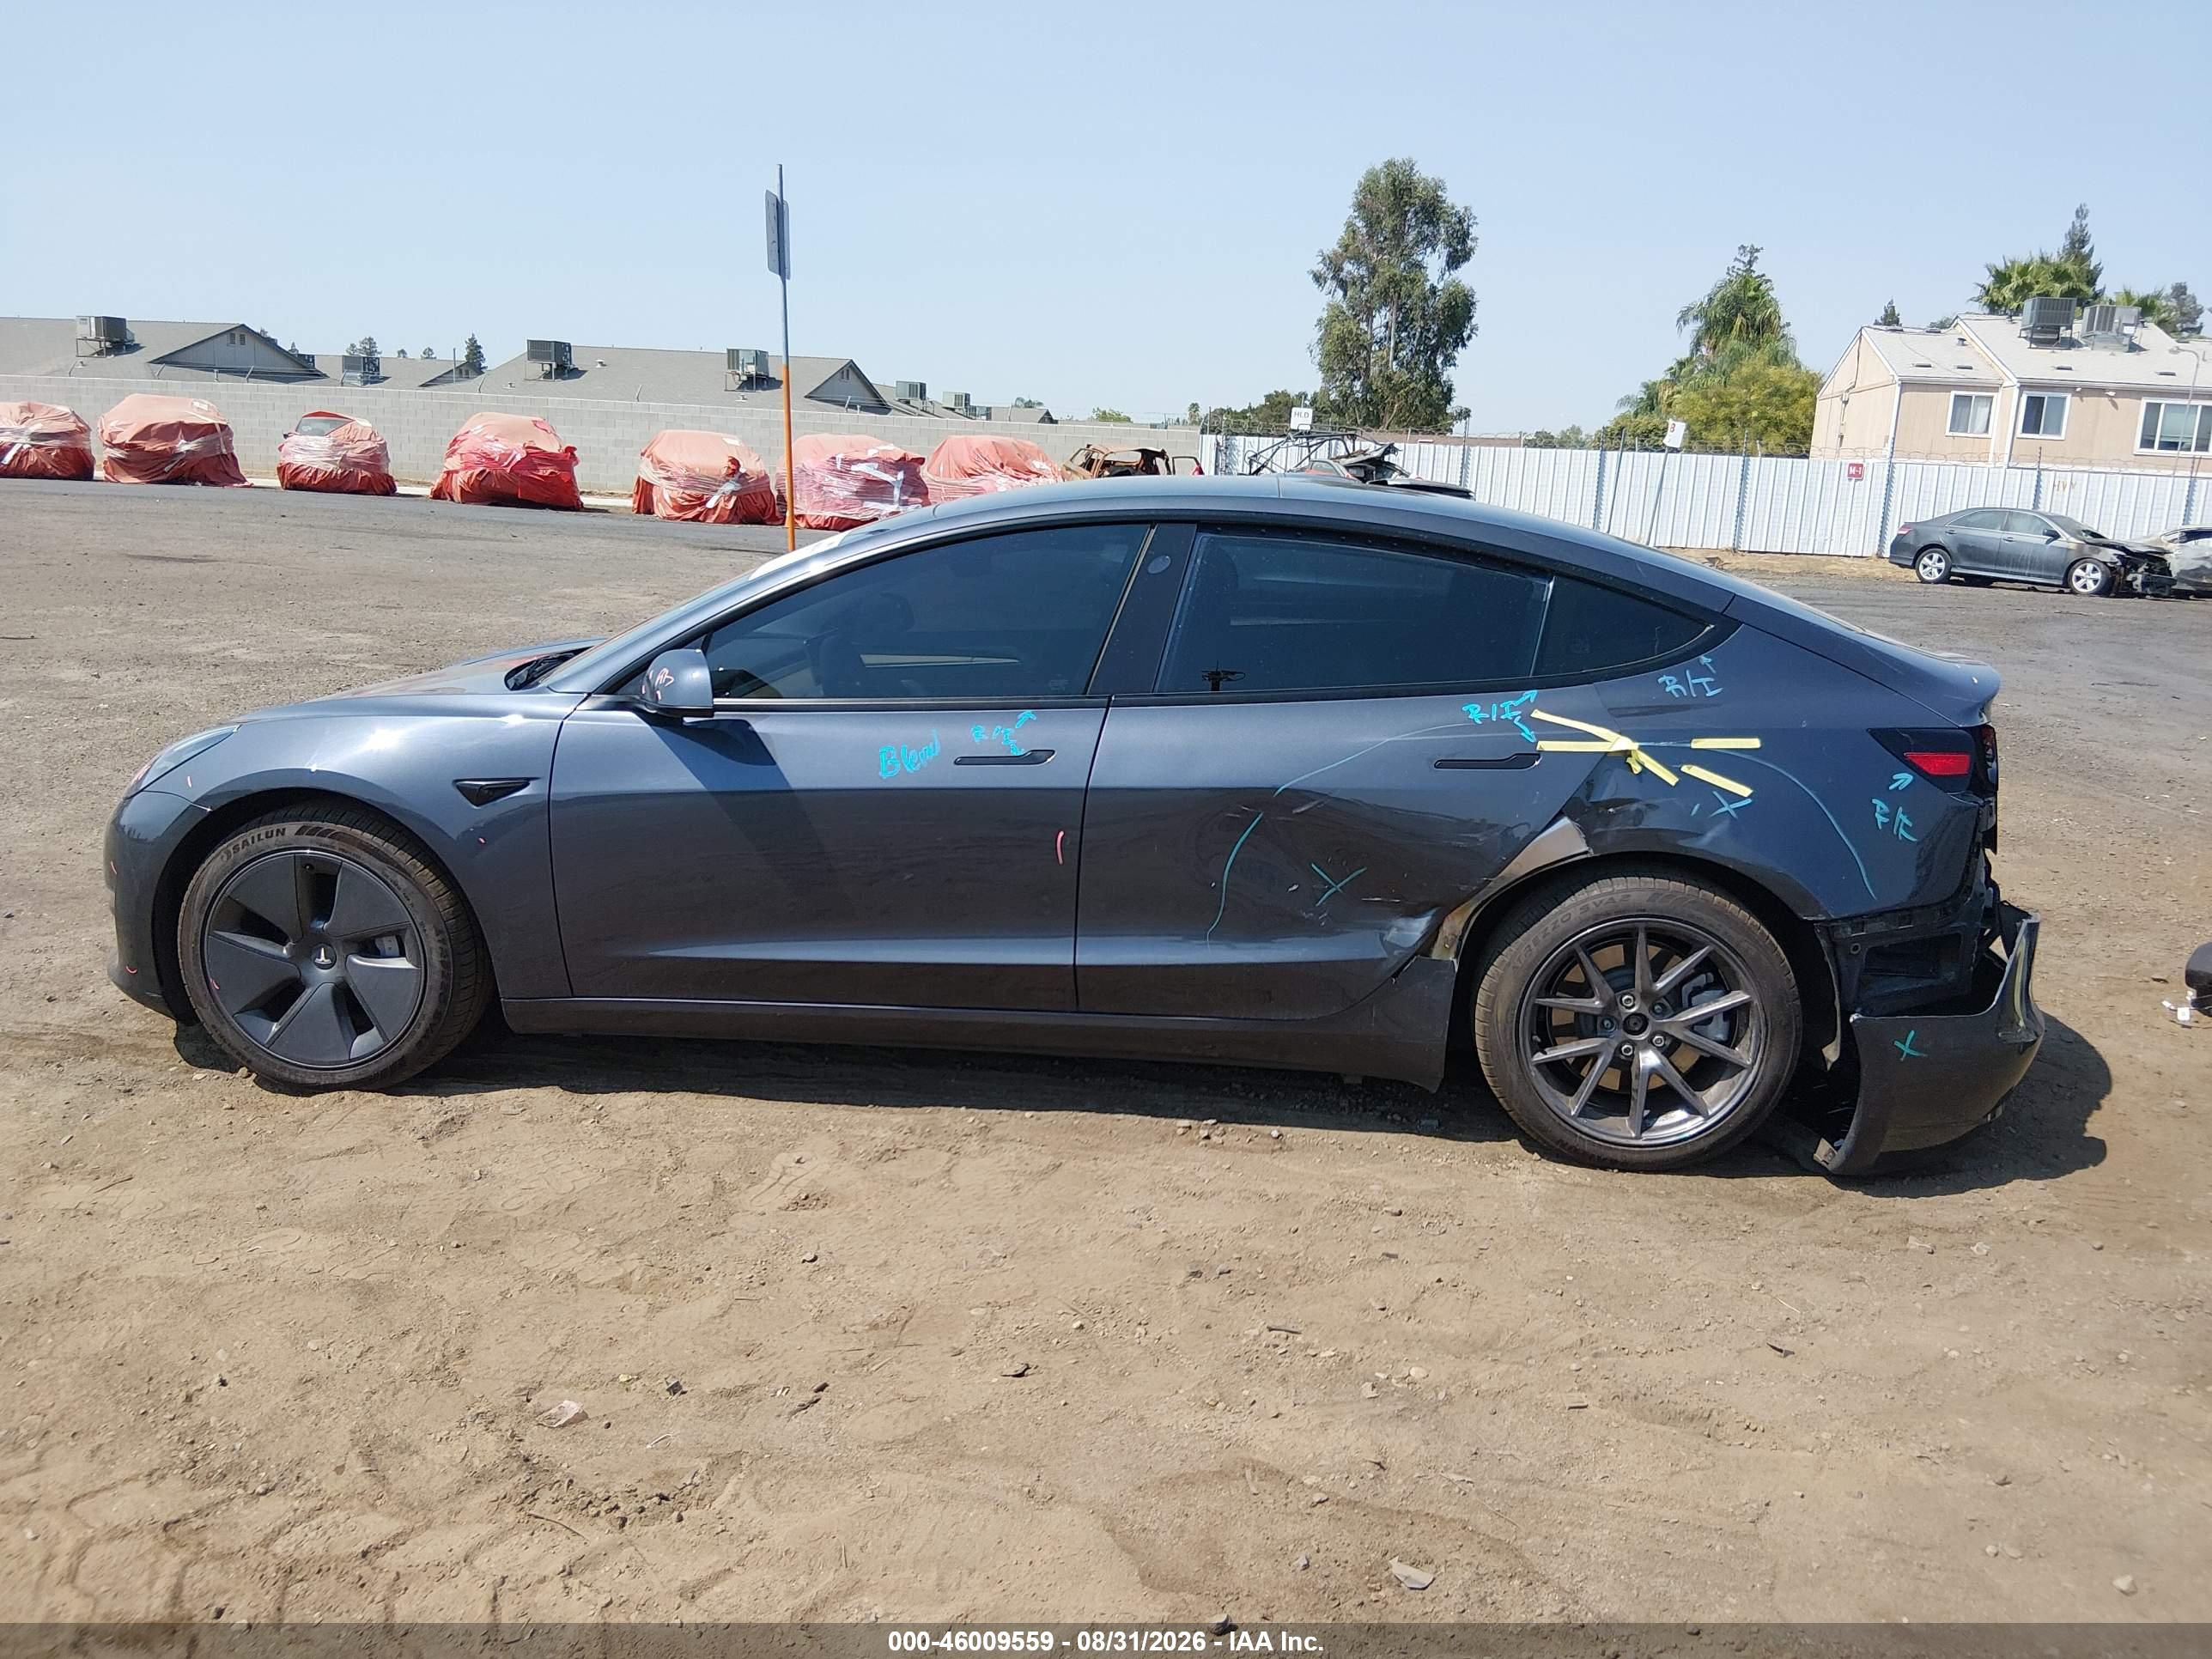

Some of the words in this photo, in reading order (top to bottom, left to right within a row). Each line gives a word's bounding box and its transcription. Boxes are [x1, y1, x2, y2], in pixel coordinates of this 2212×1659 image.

[1849, 465, 1863, 475] M-1
[879, 729, 941, 779] Blend
[232, 827, 287, 854] SAILUN
[1579, 894, 1632, 915] SVA2
